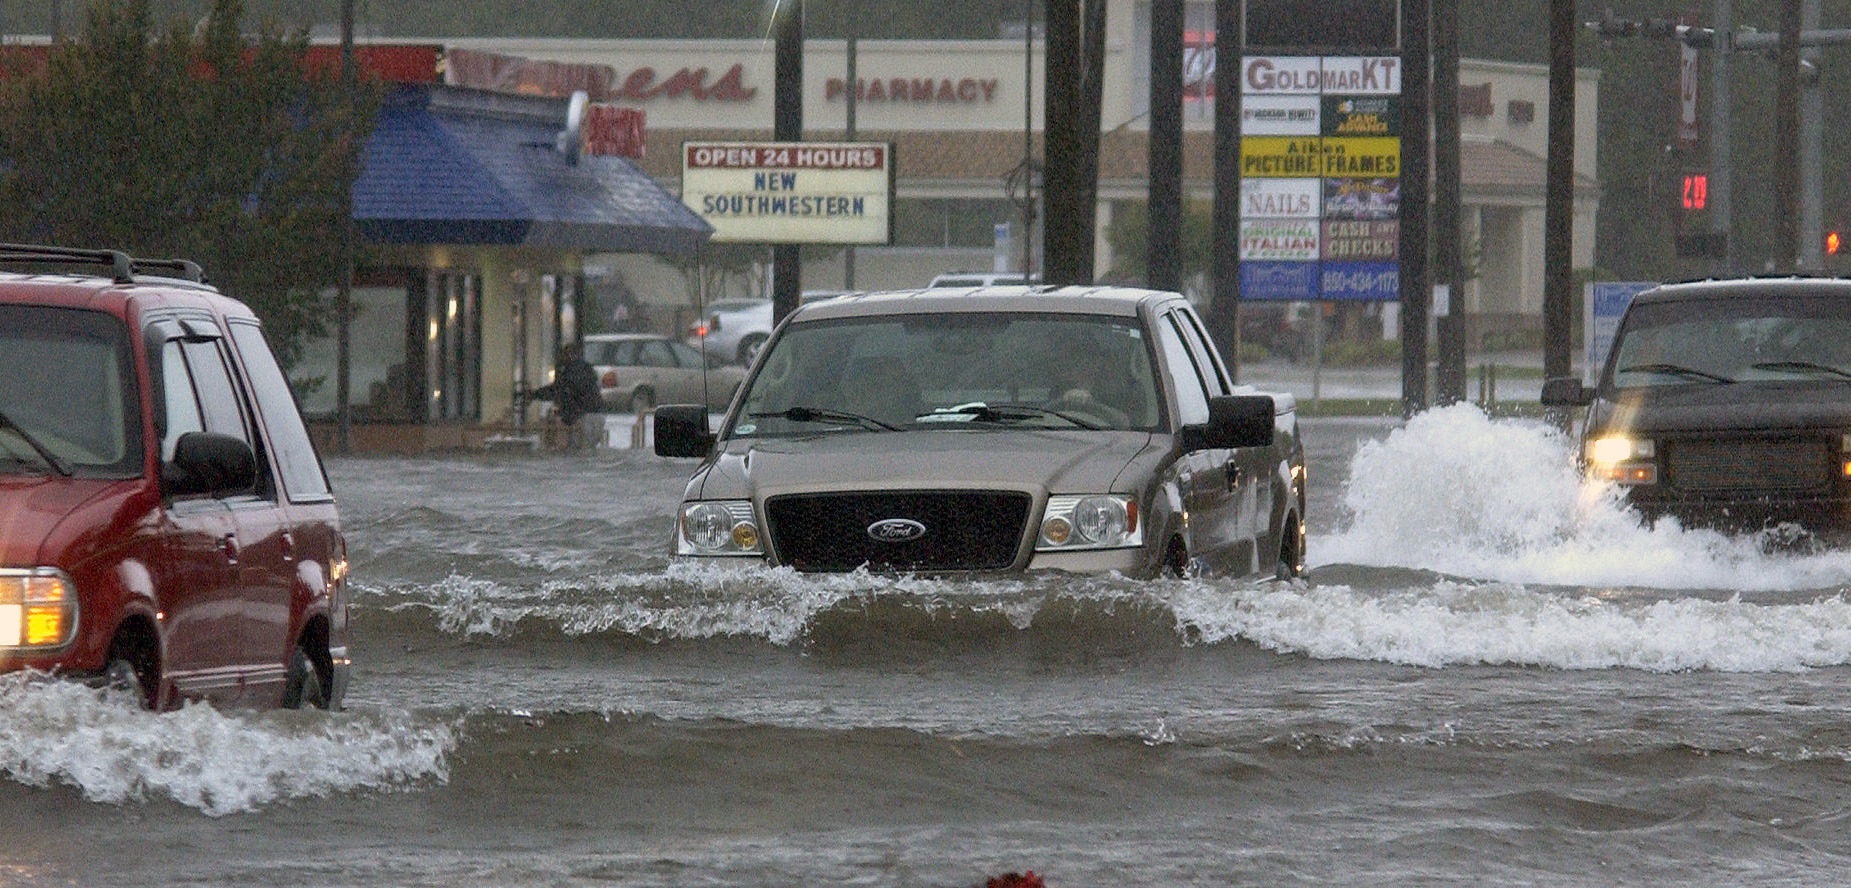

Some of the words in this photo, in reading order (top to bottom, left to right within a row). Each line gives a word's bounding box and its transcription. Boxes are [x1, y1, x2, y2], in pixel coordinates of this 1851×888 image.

[695, 148, 756, 166] OPEN
[763, 149, 789, 167] 24
[798, 149, 877, 168] HOURS
[1245, 155, 1316, 173] PICTURE
[1326, 155, 1396, 173] FRAMES
[754, 172, 797, 191] NEW
[703, 194, 865, 216] SOUTHWESTERN
[1248, 193, 1311, 214] NAILS
[1329, 222, 1370, 236] CASH
[1242, 238, 1317, 250] ITALIAN
[1329, 239, 1394, 256] CHECKS
[879, 523, 913, 537] Ford
